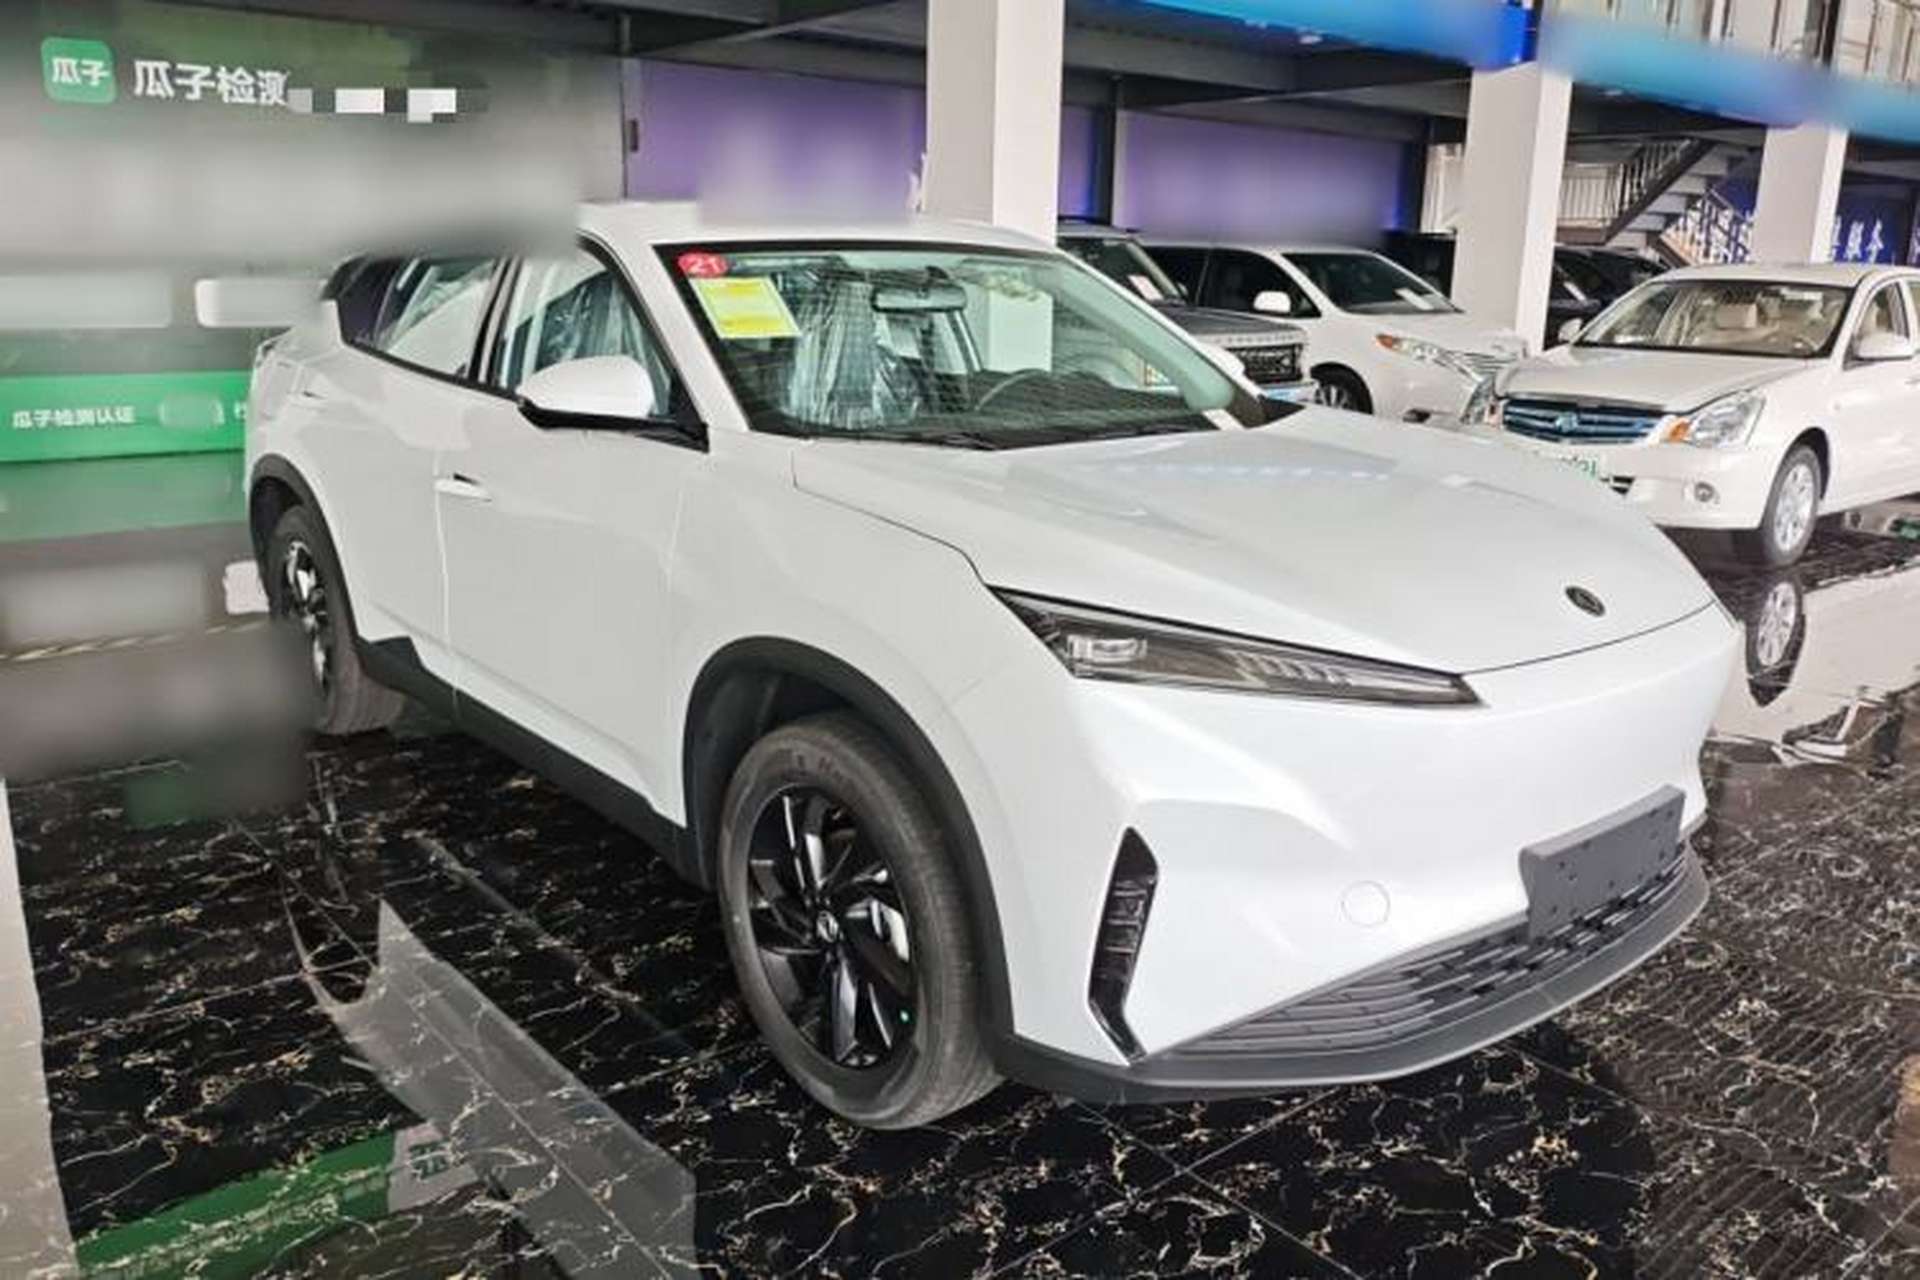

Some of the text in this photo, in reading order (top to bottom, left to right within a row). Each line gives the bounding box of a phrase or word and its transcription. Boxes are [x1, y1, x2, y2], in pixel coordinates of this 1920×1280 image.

[52, 57, 110, 86] 瓜子
[12, 405, 136, 429] 瓜子检测认证
